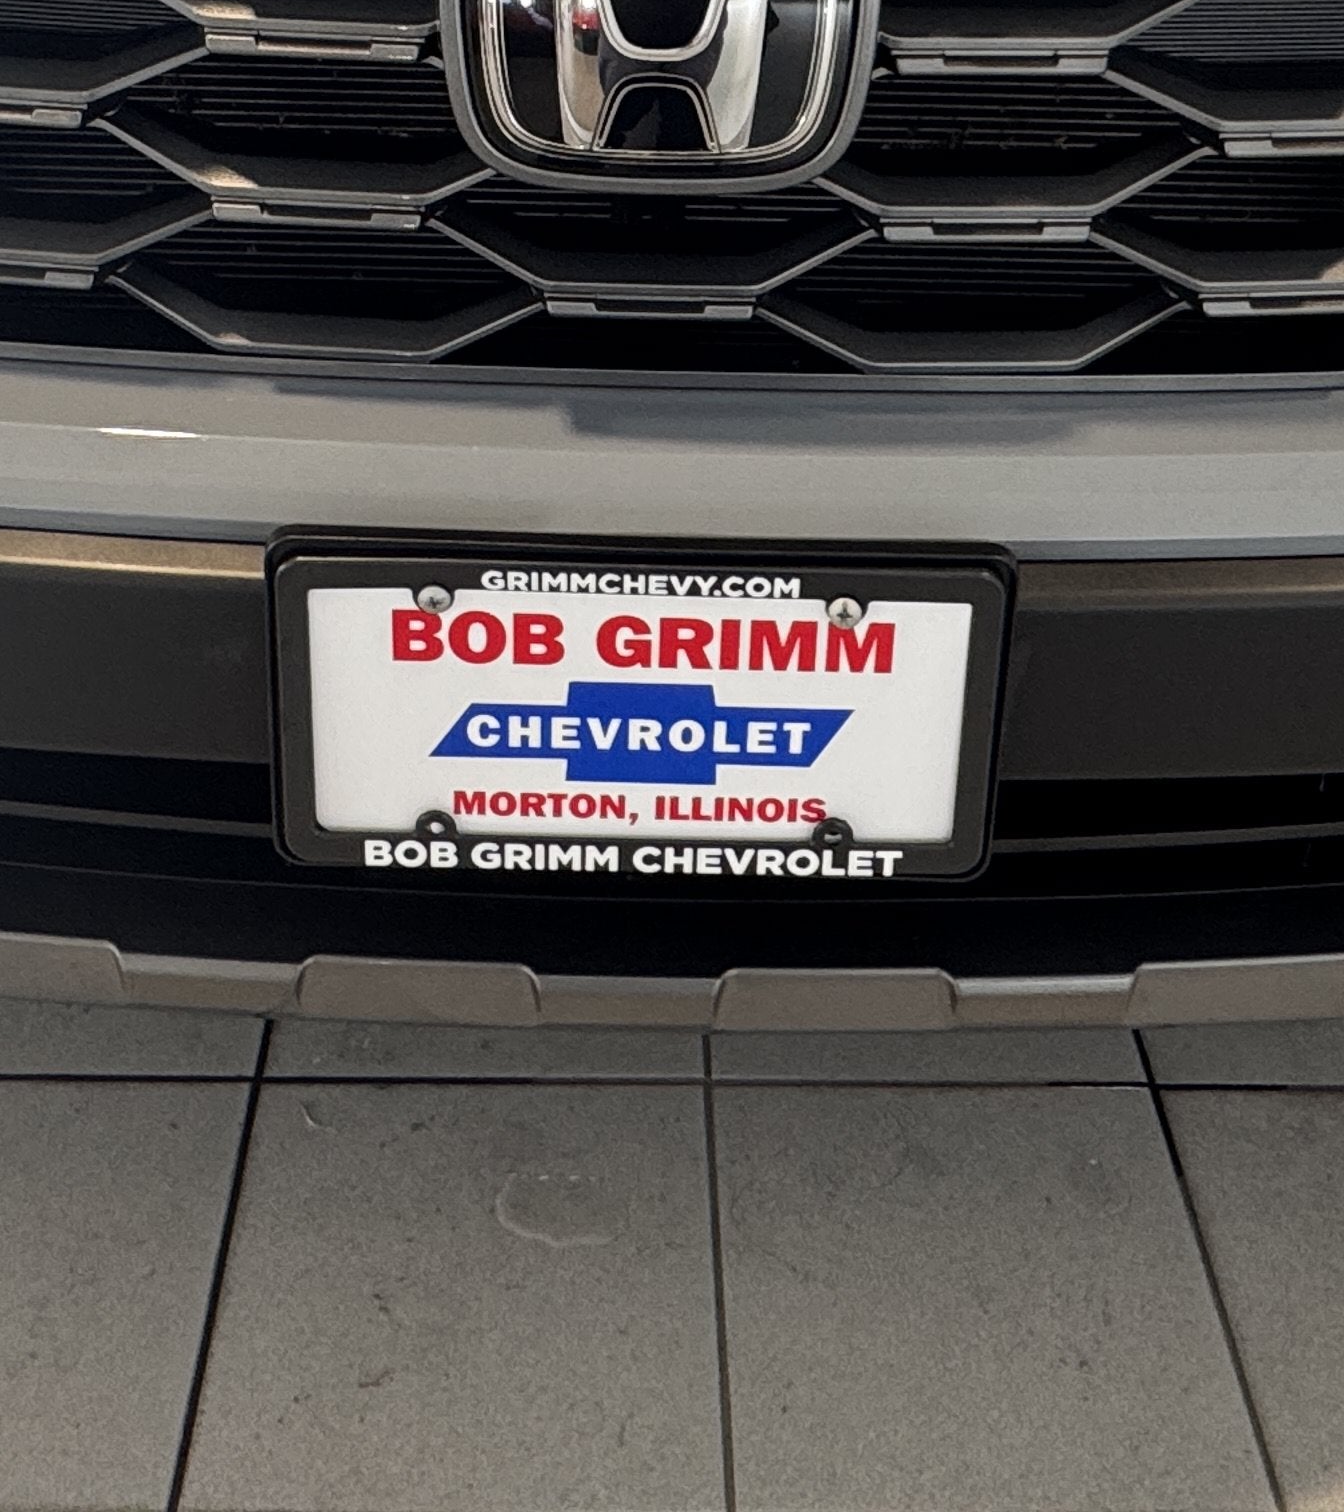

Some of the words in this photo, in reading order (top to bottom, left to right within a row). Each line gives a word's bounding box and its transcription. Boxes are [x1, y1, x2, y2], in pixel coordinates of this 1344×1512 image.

[480, 569, 802, 599] GRIMMCHEVY.COM
[390, 608, 566, 667] BOB
[594, 615, 897, 675] GRIMM
[465, 714, 812, 755] CHEVROLET
[452, 791, 640, 826] MORTON,
[654, 796, 827, 824] ILLINOIS
[363, 838, 460, 869] BOB
[469, 841, 620, 873] GRIMM
[631, 845, 904, 878] CHEVROLET
